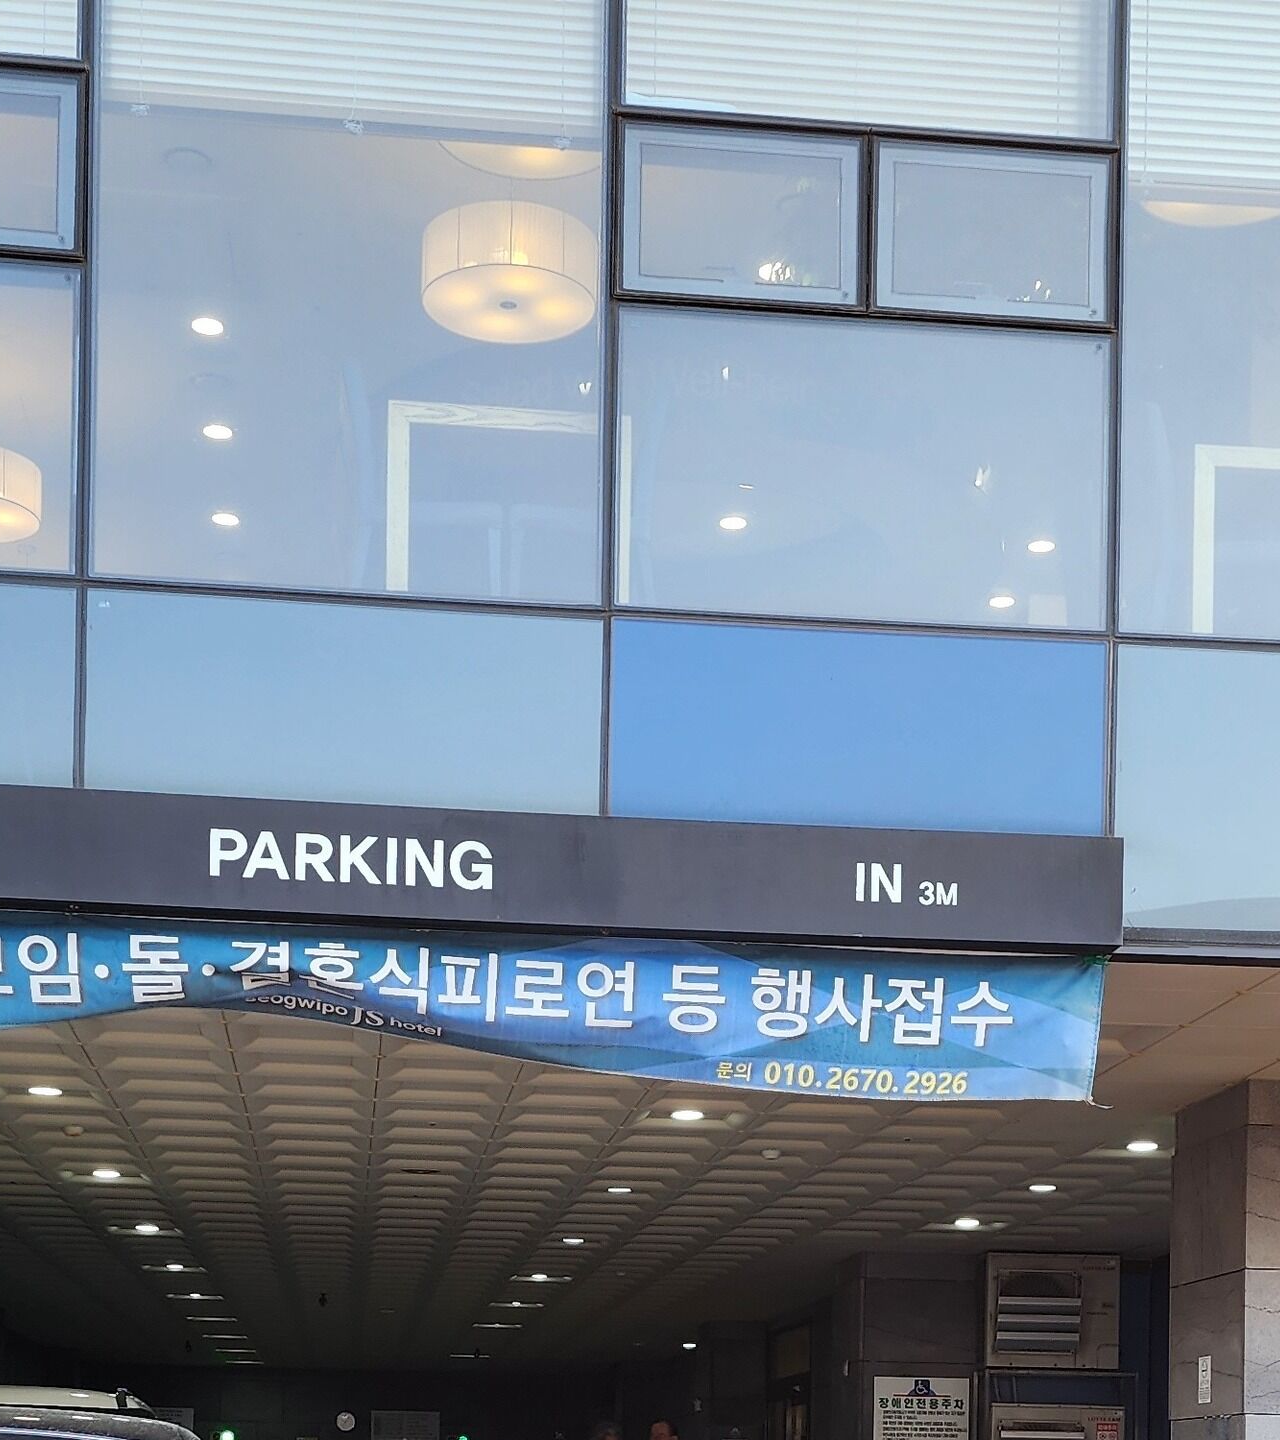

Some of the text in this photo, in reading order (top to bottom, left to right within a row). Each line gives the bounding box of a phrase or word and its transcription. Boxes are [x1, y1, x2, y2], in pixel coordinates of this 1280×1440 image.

[208, 827, 494, 891] PARKING
[855, 862, 958, 906] IN 3M
[350, 1005, 385, 1027] JS
[389, 1016, 443, 1037] hotel
[661, 964, 726, 1033] 등
[750, 967, 1014, 1047] 행사접수
[716, 1061, 752, 1082] 문의
